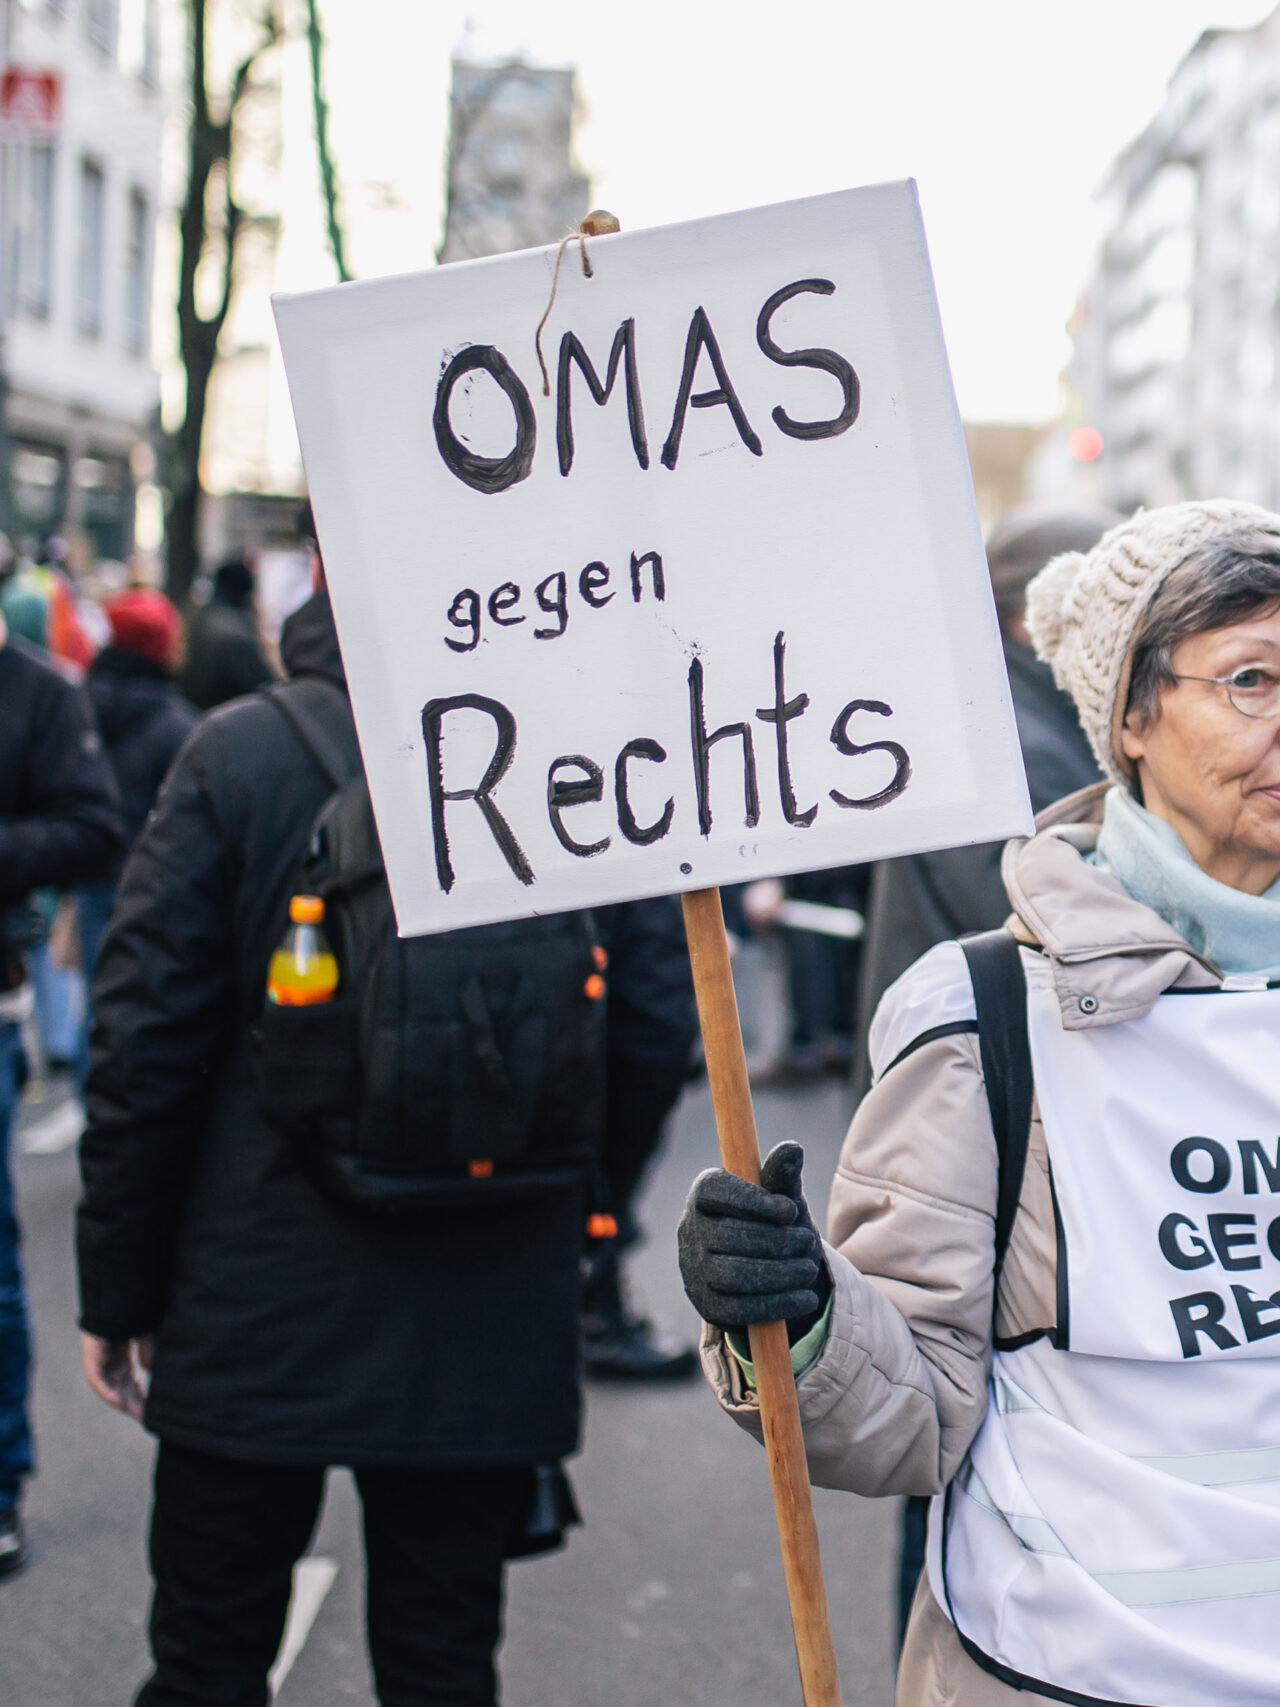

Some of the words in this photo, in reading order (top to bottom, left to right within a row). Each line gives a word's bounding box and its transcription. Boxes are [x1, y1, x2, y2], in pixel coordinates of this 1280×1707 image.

[433, 278, 860, 494] OMAS
[444, 550, 665, 652] gegen
[422, 630, 912, 894] Rechts
